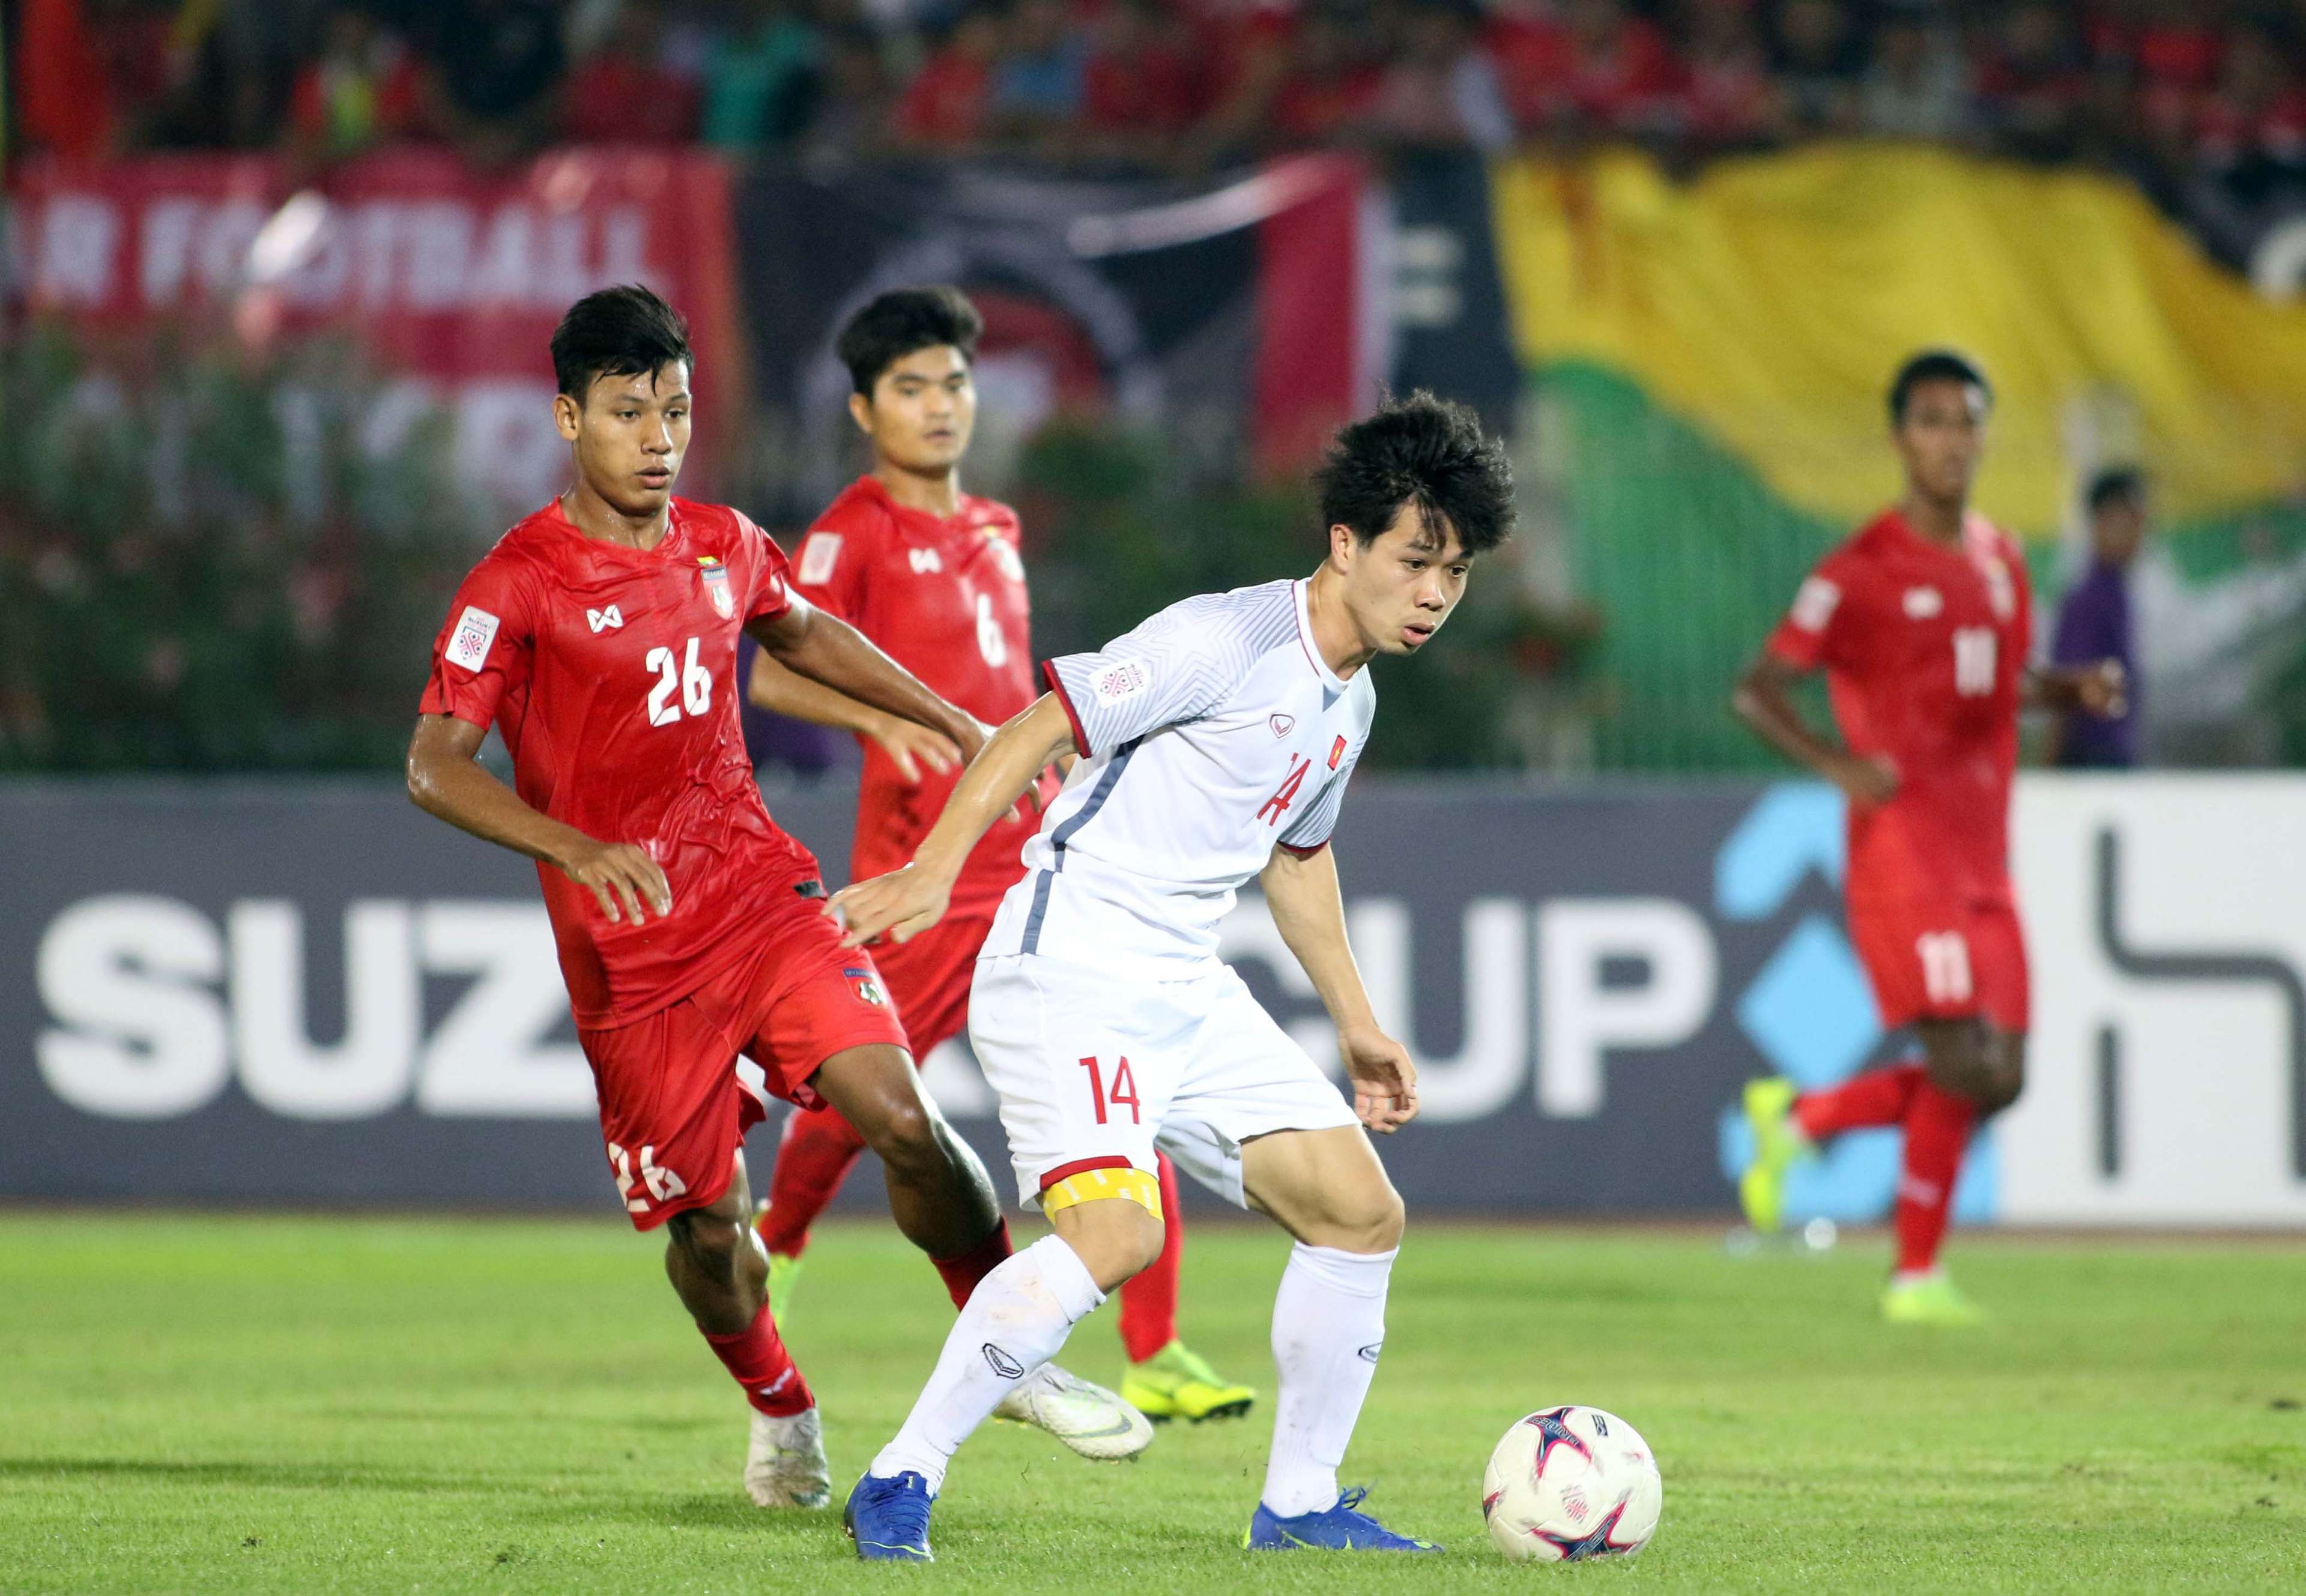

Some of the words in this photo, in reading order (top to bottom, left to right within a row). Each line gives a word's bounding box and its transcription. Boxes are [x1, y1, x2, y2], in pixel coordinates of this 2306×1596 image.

[976, 592, 1008, 668] 6
[645, 636, 712, 728] 26
[35, 891, 990, 1122] SUZ
[1079, 1055, 1141, 1125] 14
[608, 1141, 687, 1213] 26
